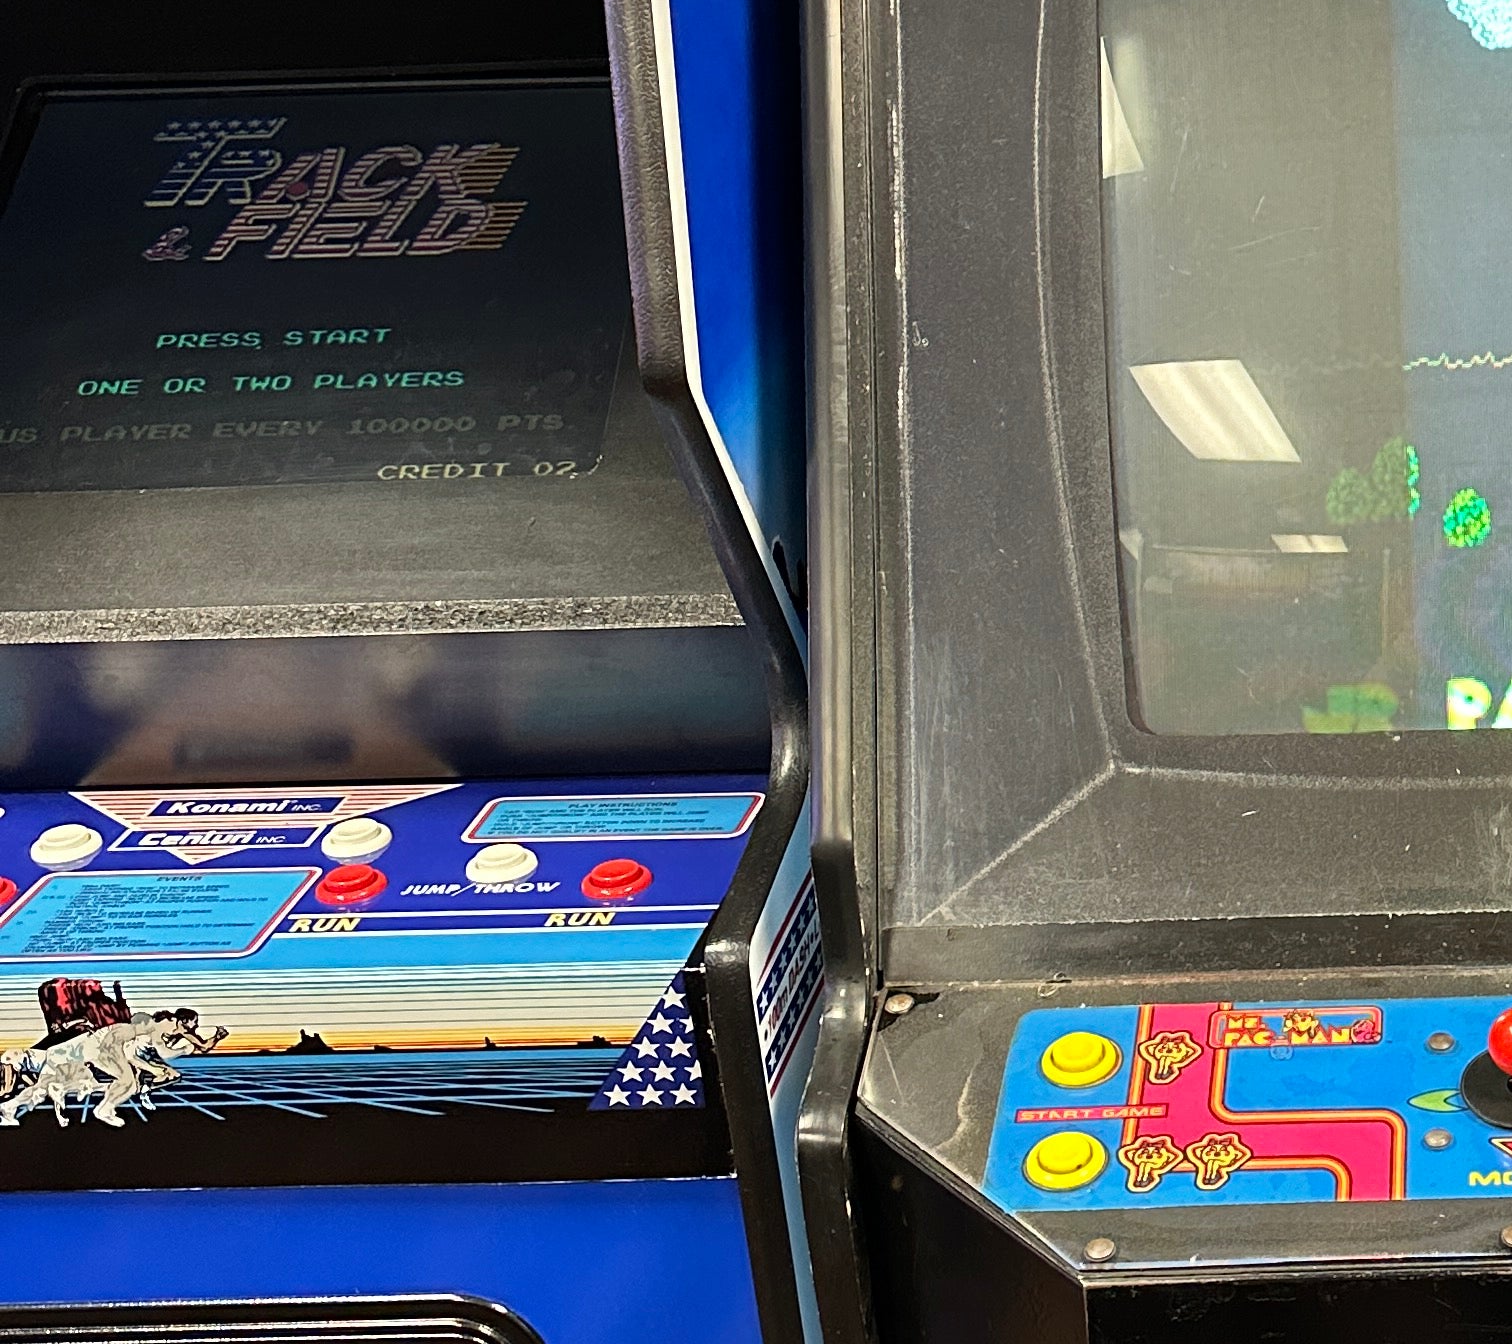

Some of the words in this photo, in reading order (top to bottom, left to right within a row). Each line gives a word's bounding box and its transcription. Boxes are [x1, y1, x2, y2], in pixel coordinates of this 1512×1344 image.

[144, 117, 520, 207] TRACK
[203, 200, 528, 262] FIELD
[157, 331, 261, 350] PRESS
[283, 327, 392, 346] START
[78, 378, 142, 397] ONE
[164, 376, 206, 394] OR
[233, 374, 292, 392] TWO
[314, 370, 466, 390] PLAYERS
[60, 423, 193, 443] PLAYER
[212, 419, 323, 440] EVERY
[347, 416, 476, 435] 100000
[497, 414, 564, 432] PTS
[377, 461, 510, 482] CREDIT
[534, 459, 577, 478] 02
[166, 800, 290, 815] Konami
[138, 830, 257, 847] Centuri
[401, 881, 562, 898] JUMP/THROW
[288, 917, 363, 934] RUN
[545, 912, 617, 929] RUN
[1021, 1108, 1095, 1121] START
[1102, 1106, 1165, 1119] GAME
